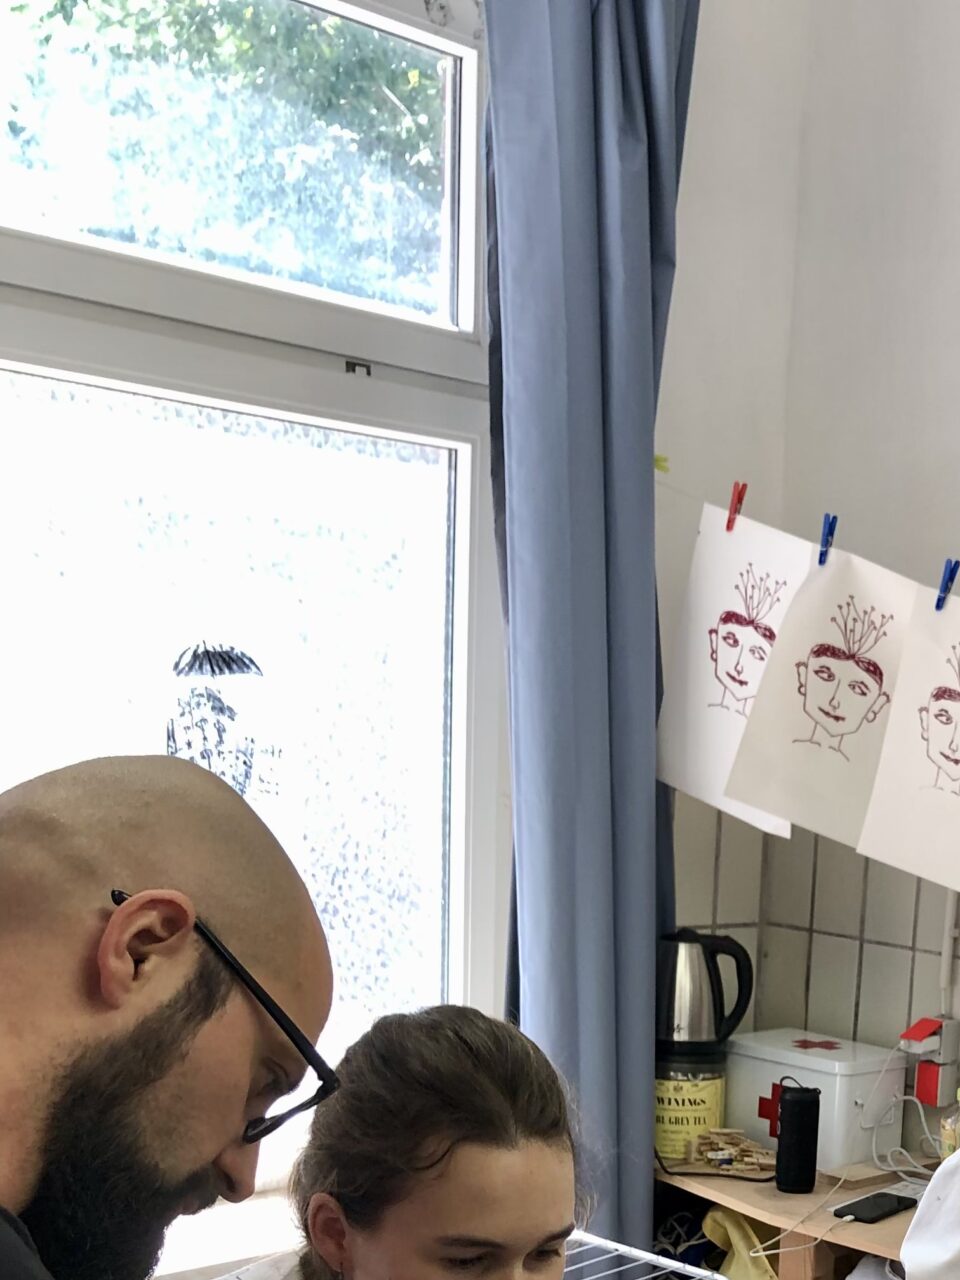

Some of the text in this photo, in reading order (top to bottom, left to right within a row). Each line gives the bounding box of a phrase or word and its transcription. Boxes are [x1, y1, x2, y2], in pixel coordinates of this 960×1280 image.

[656, 1096, 706, 1107] WININGS
[669, 1116, 690, 1126] GREY
[693, 1116, 707, 1126] TEA
